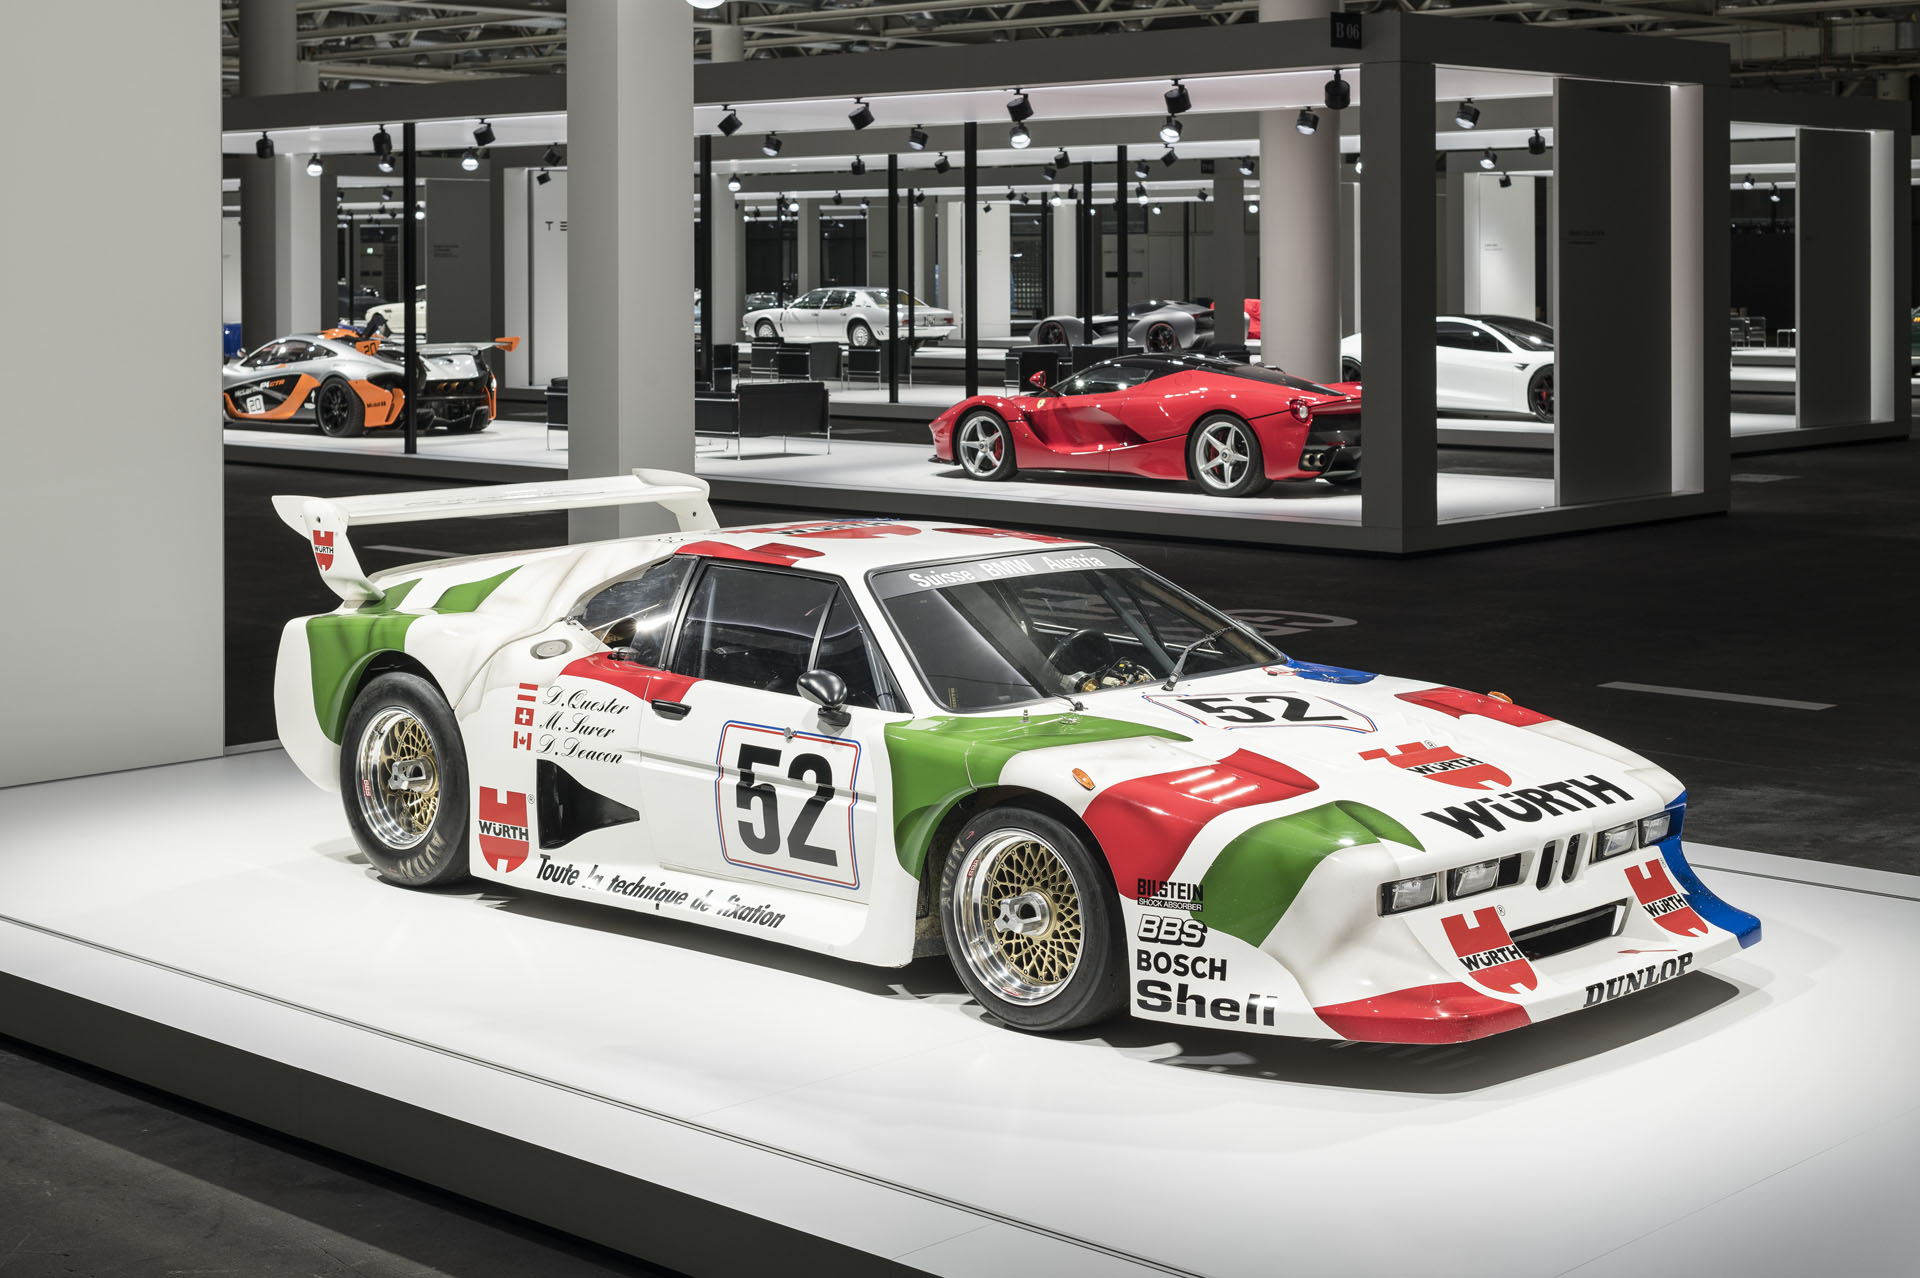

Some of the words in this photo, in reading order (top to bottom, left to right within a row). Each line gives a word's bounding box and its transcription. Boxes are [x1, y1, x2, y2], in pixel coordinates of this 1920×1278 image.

[249, 397, 262, 412] 20
[908, 568, 975, 588] Suisse
[978, 558, 1036, 577] BMW
[1042, 553, 1106, 570] Austria
[1177, 695, 1349, 724] 52
[1406, 756, 1484, 775] WÜRTH
[736, 743, 838, 867] 52
[1420, 774, 1635, 840] WÜRTH
[479, 820, 529, 841] WÜRTH
[536, 853, 580, 886] Toute
[606, 874, 689, 909] technique
[1137, 878, 1204, 901] BILSTEIN
[1138, 898, 1163, 908] SHOCK
[1163, 900, 1203, 911] ABSORBER
[1643, 894, 1688, 917] WÜRTH
[1137, 913, 1208, 947] BBS
[1137, 949, 1228, 981] BOSCH
[1458, 944, 1525, 972] WÜRTH
[1583, 951, 1694, 1008] DUNLOP
[1137, 979, 1278, 1026] Shell
